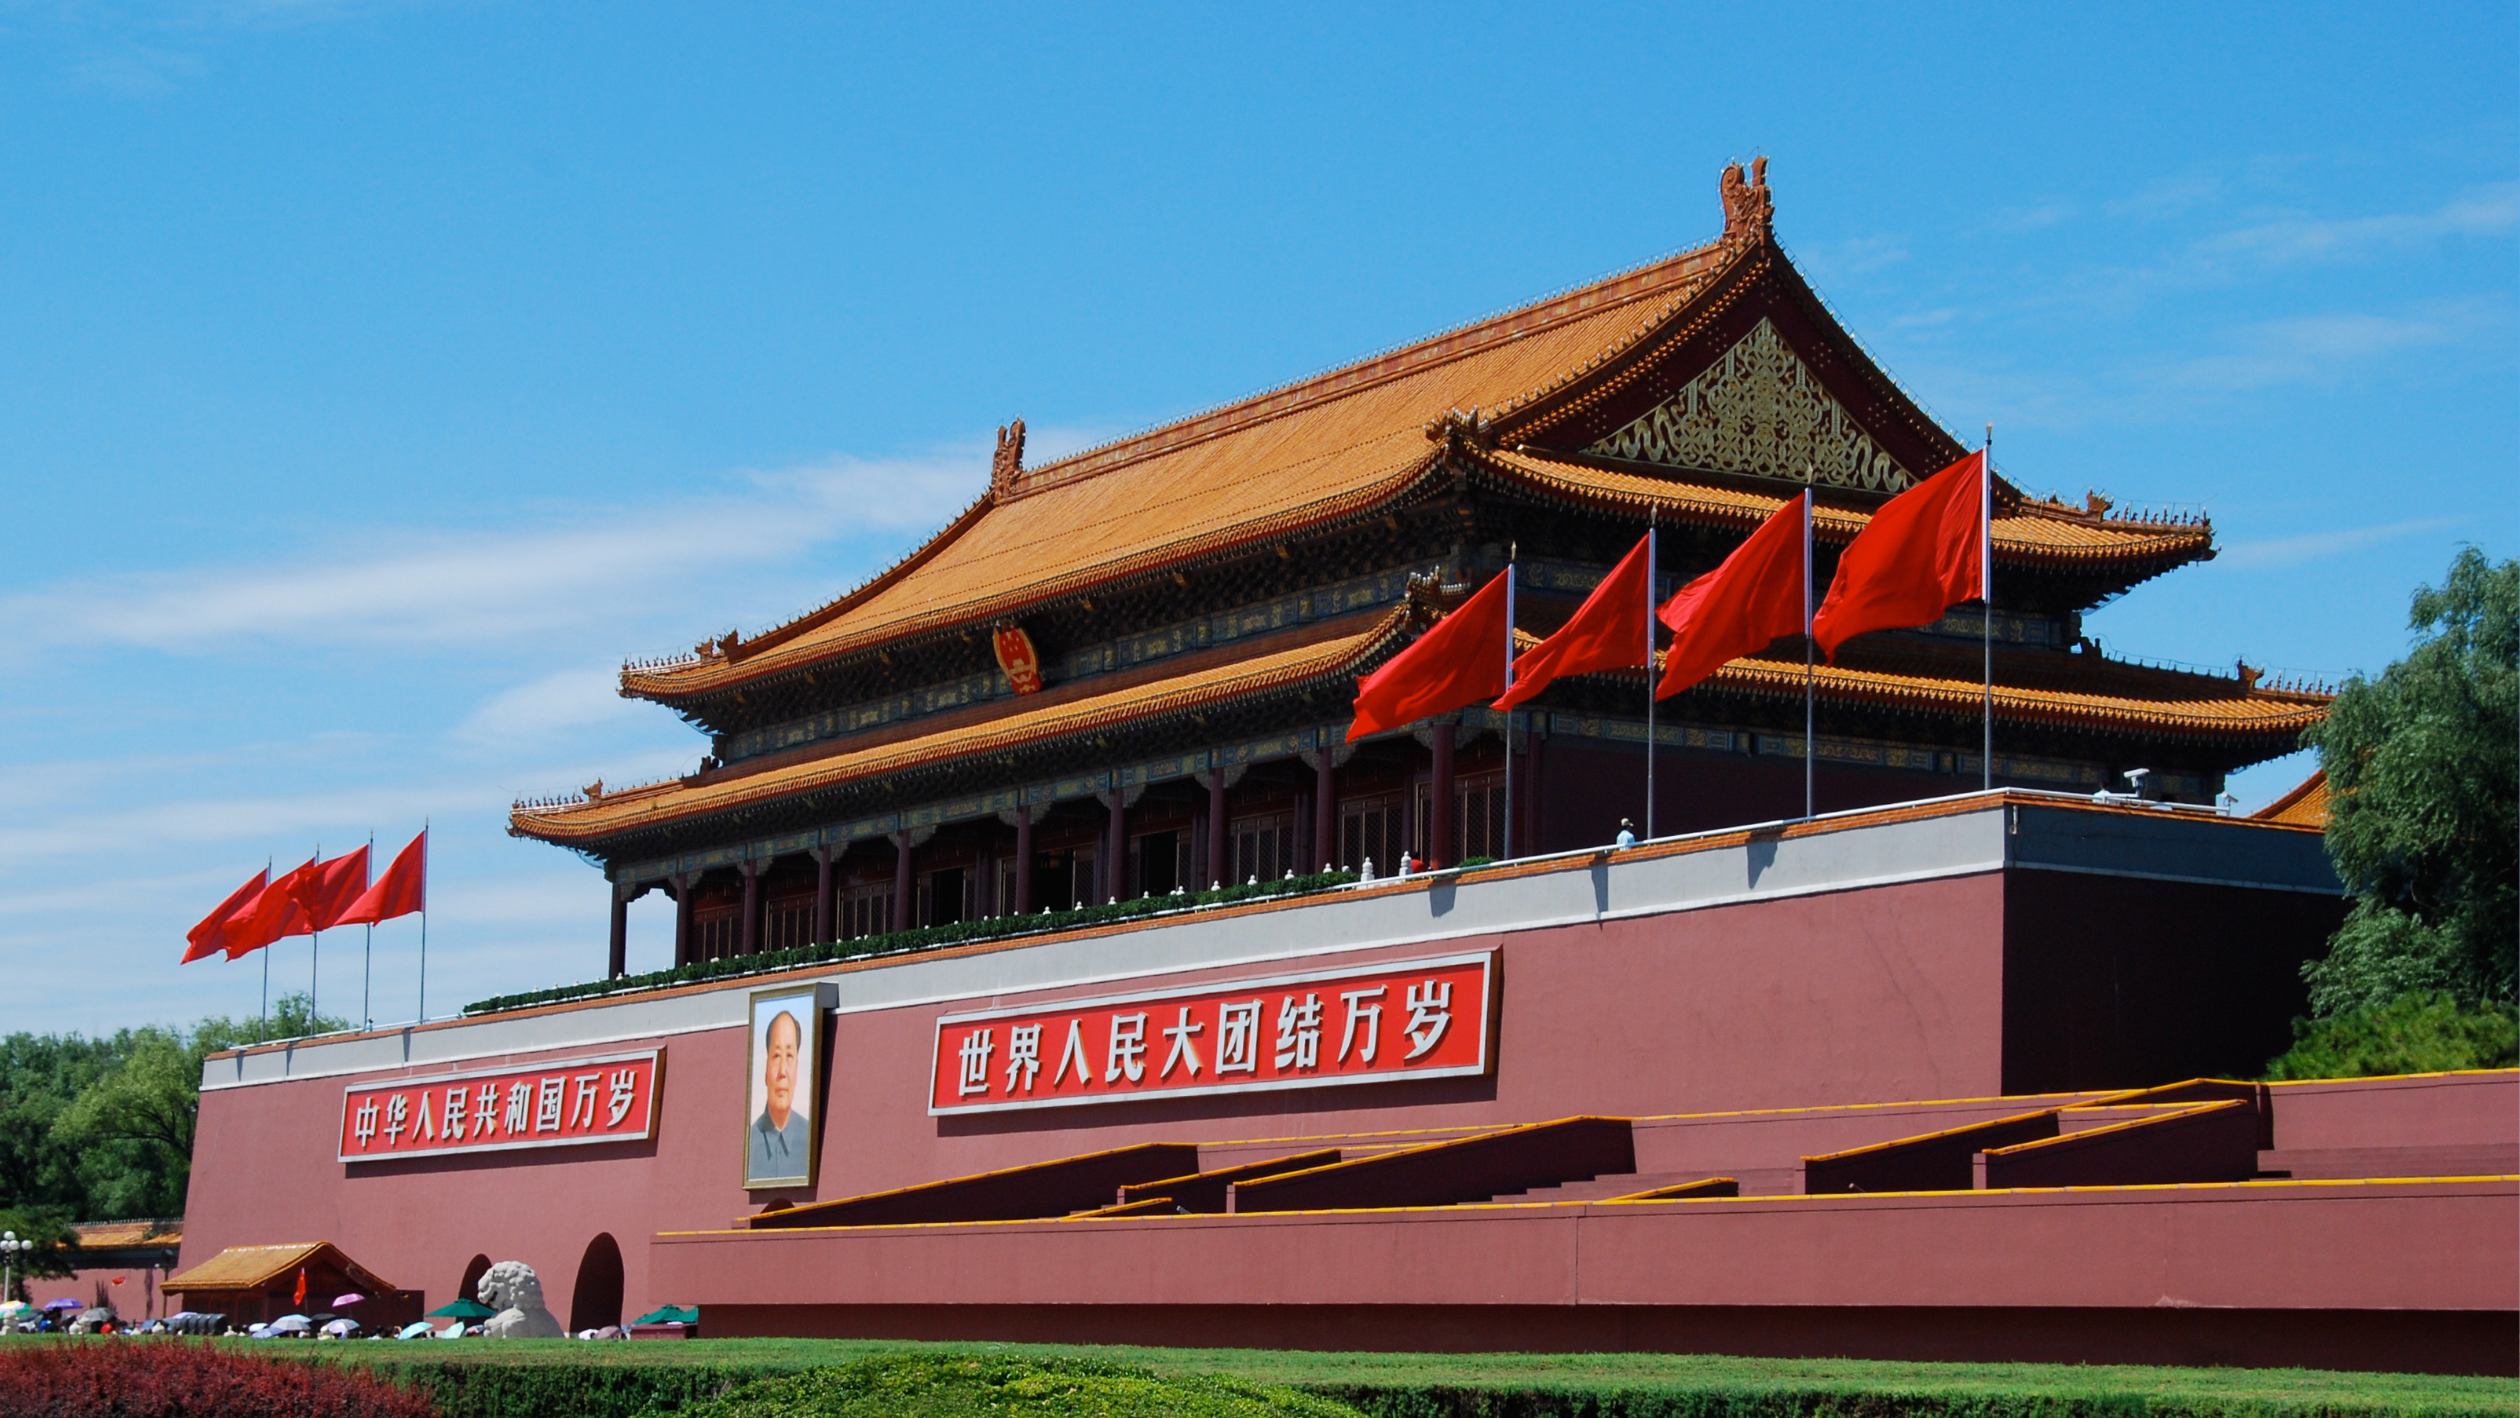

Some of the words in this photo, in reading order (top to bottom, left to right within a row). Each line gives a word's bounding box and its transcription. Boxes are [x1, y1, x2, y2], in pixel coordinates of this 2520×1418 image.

[958, 980, 1453, 1096] 世界人民大团结万岁
[355, 1069, 636, 1147] 中华人民共和国万岁
